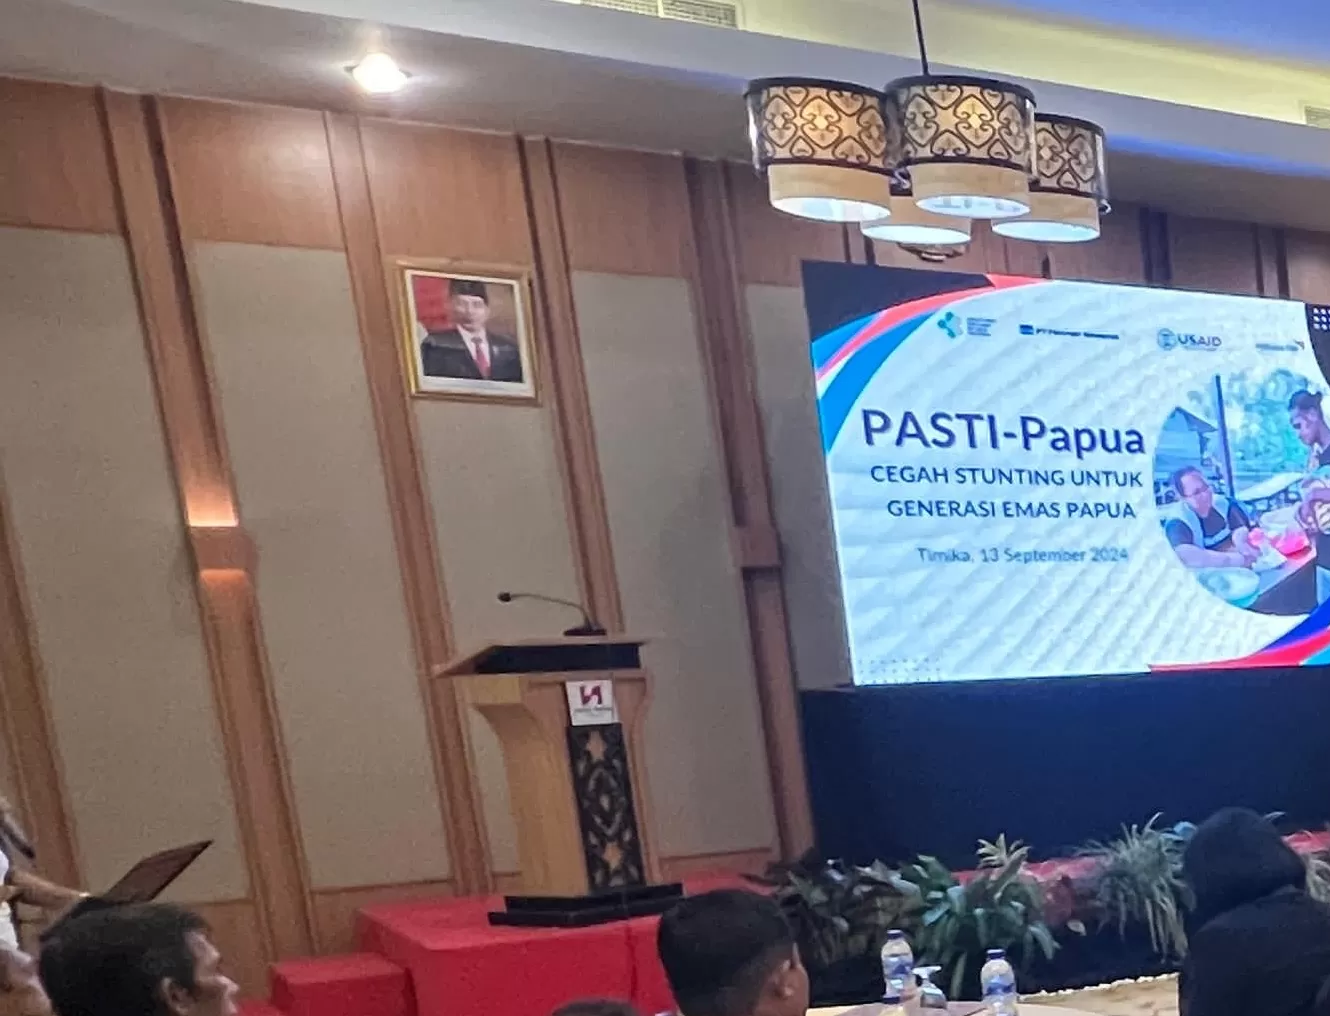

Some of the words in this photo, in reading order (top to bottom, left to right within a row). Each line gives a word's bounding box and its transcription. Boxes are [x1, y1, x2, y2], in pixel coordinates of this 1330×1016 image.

[1177, 334, 1222, 347] USAID
[861, 408, 1146, 460] PASTI-Papua
[870, 465, 949, 484] CEGAH
[954, 467, 1065, 486] STUNTING
[1070, 470, 1143, 488] UNTUK
[887, 500, 996, 518] GENERASI
[1003, 502, 1060, 518] EMAS
[1066, 502, 1136, 519] PAPUA
[918, 548, 975, 564] Timika,
[981, 548, 998, 562] 13
[1003, 548, 1087, 564] September
[1091, 548, 1129, 563] 2024
